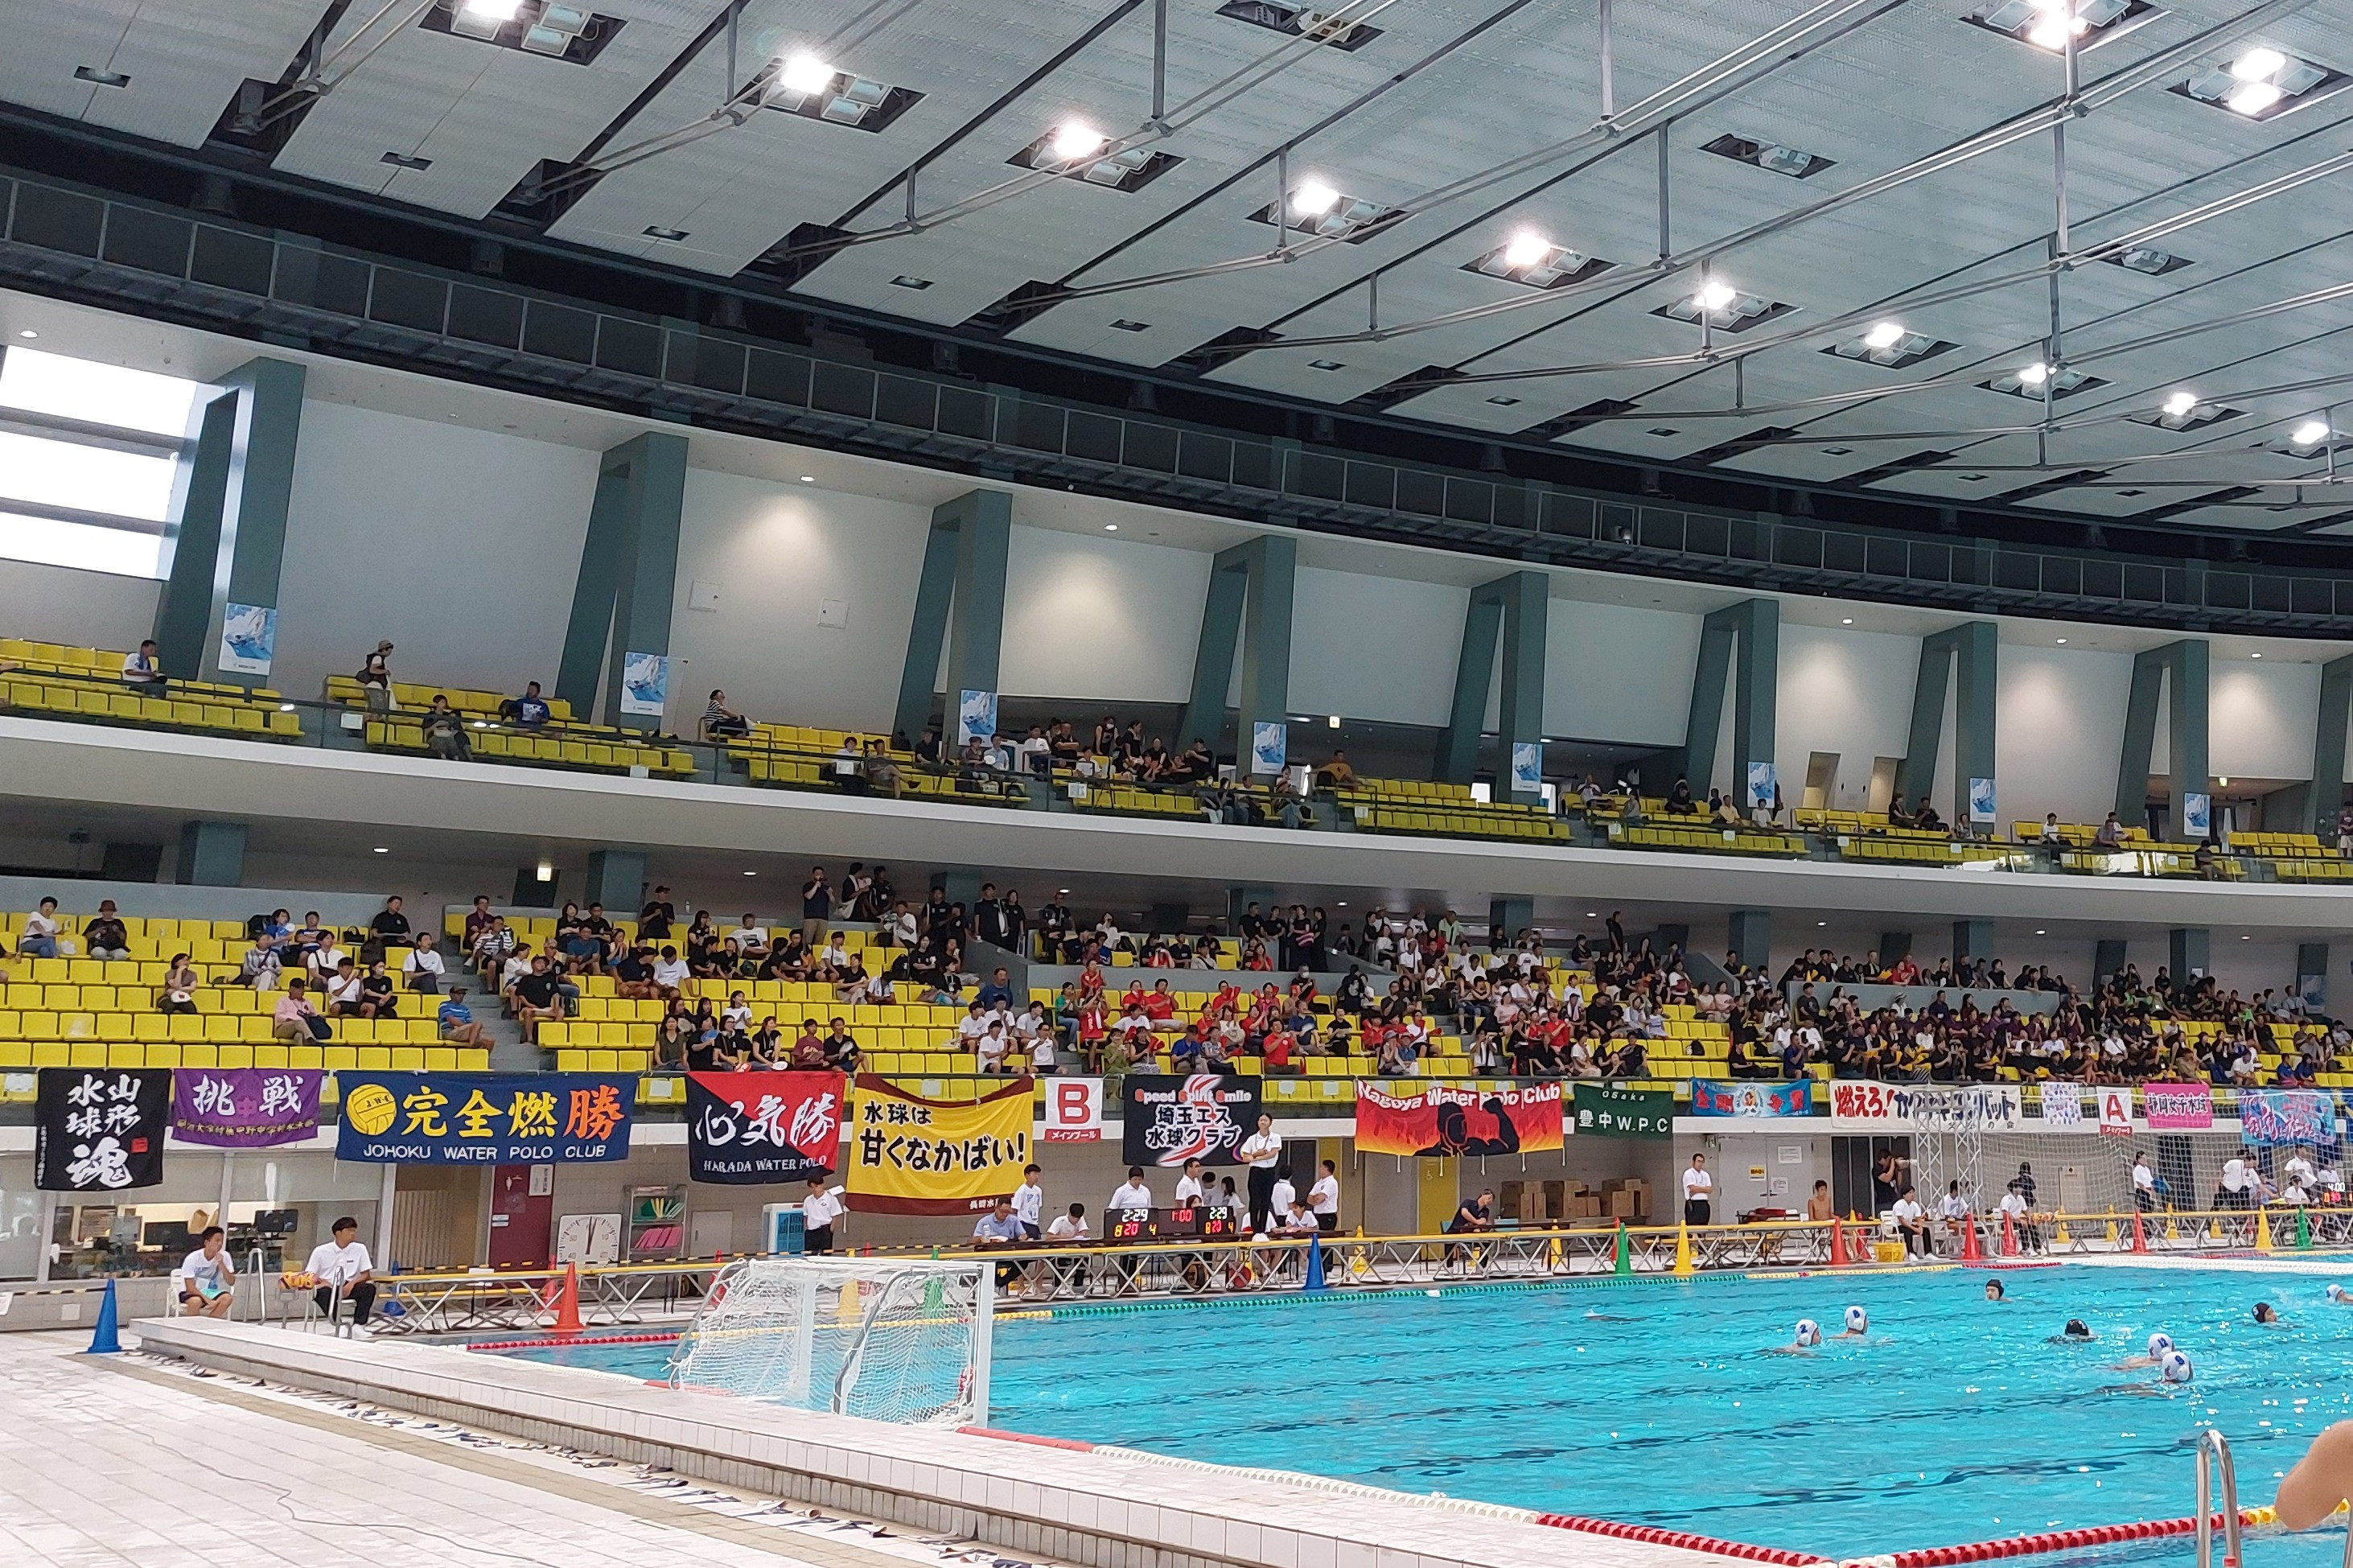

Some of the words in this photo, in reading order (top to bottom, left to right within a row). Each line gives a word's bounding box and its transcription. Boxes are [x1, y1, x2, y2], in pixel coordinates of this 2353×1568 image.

[65, 1073, 105, 1139] 水球
[105, 1073, 142, 1135] 山形
[192, 1074, 303, 1117] 挑戦
[1057, 1083, 1091, 1124] B
[1135, 1088, 1176, 1104] Speed
[1216, 1089, 1252, 1103] Smile
[1357, 1080, 1424, 1111] Nagoya
[1426, 1085, 1478, 1106] Water
[1523, 1084, 1561, 1109] Club
[2106, 1092, 2128, 1122] A
[401, 1084, 625, 1141] 完全燃勝
[863, 1100, 932, 1125] 水球は
[1156, 1105, 1232, 1126] 埼玉エス
[1051, 1130, 1096, 1140] メインプール
[1146, 1125, 1242, 1149] 水球クラブ
[65, 1136, 134, 1189] 魂
[364, 1144, 431, 1159] JOHOKU
[443, 1146, 497, 1160] WATER
[509, 1146, 553, 1159] POLO
[565, 1144, 607, 1159] CLUB
[703, 1159, 753, 1173] HARADA
[755, 1159, 796, 1171] WATER
[799, 1154, 827, 1170] POLO
[1122, 1209, 1149, 1222] 2:29
[1209, 1207, 1228, 1220] 2:29
[1124, 1223, 1139, 1236] 20
[1149, 1224, 1157, 1236] 4
[1800, 1323, 1808, 1334] 2
